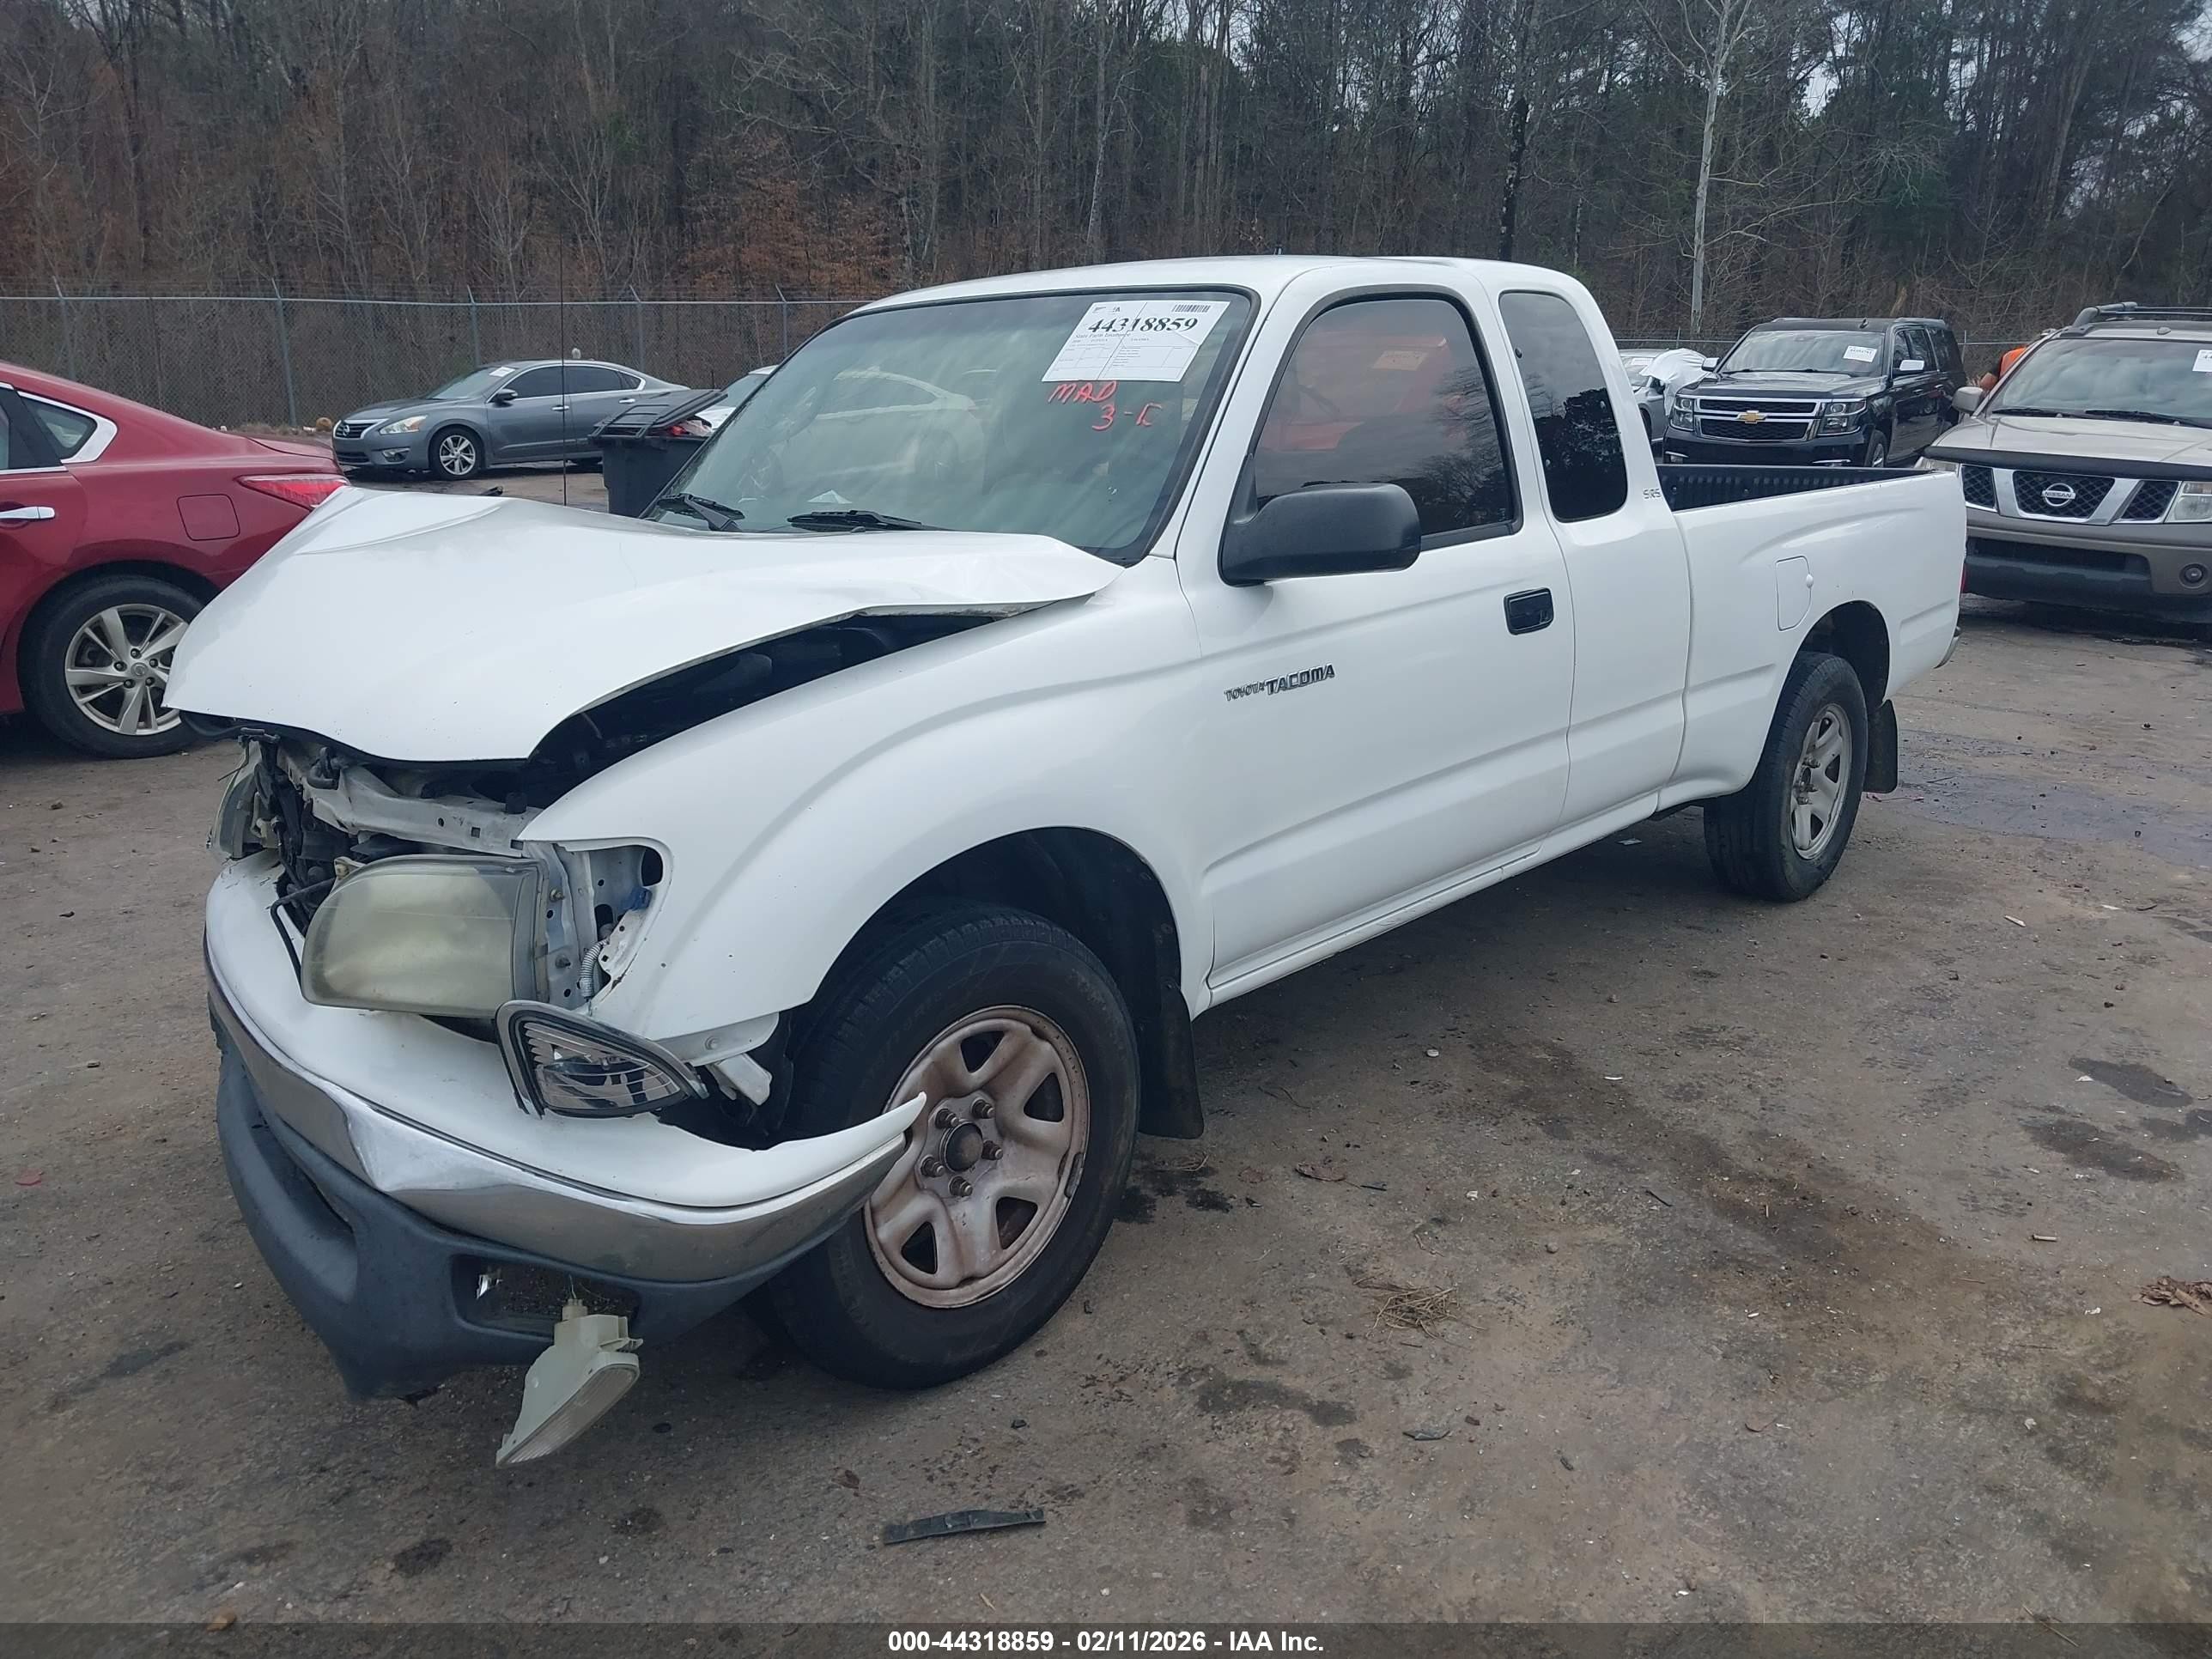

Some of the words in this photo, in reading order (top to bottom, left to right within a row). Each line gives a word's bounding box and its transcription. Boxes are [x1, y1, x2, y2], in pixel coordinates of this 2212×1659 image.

[1088, 317, 1199, 333] 44318859
[1224, 682, 1265, 702] TOYOTA
[1264, 663, 1335, 696] TACOMA
